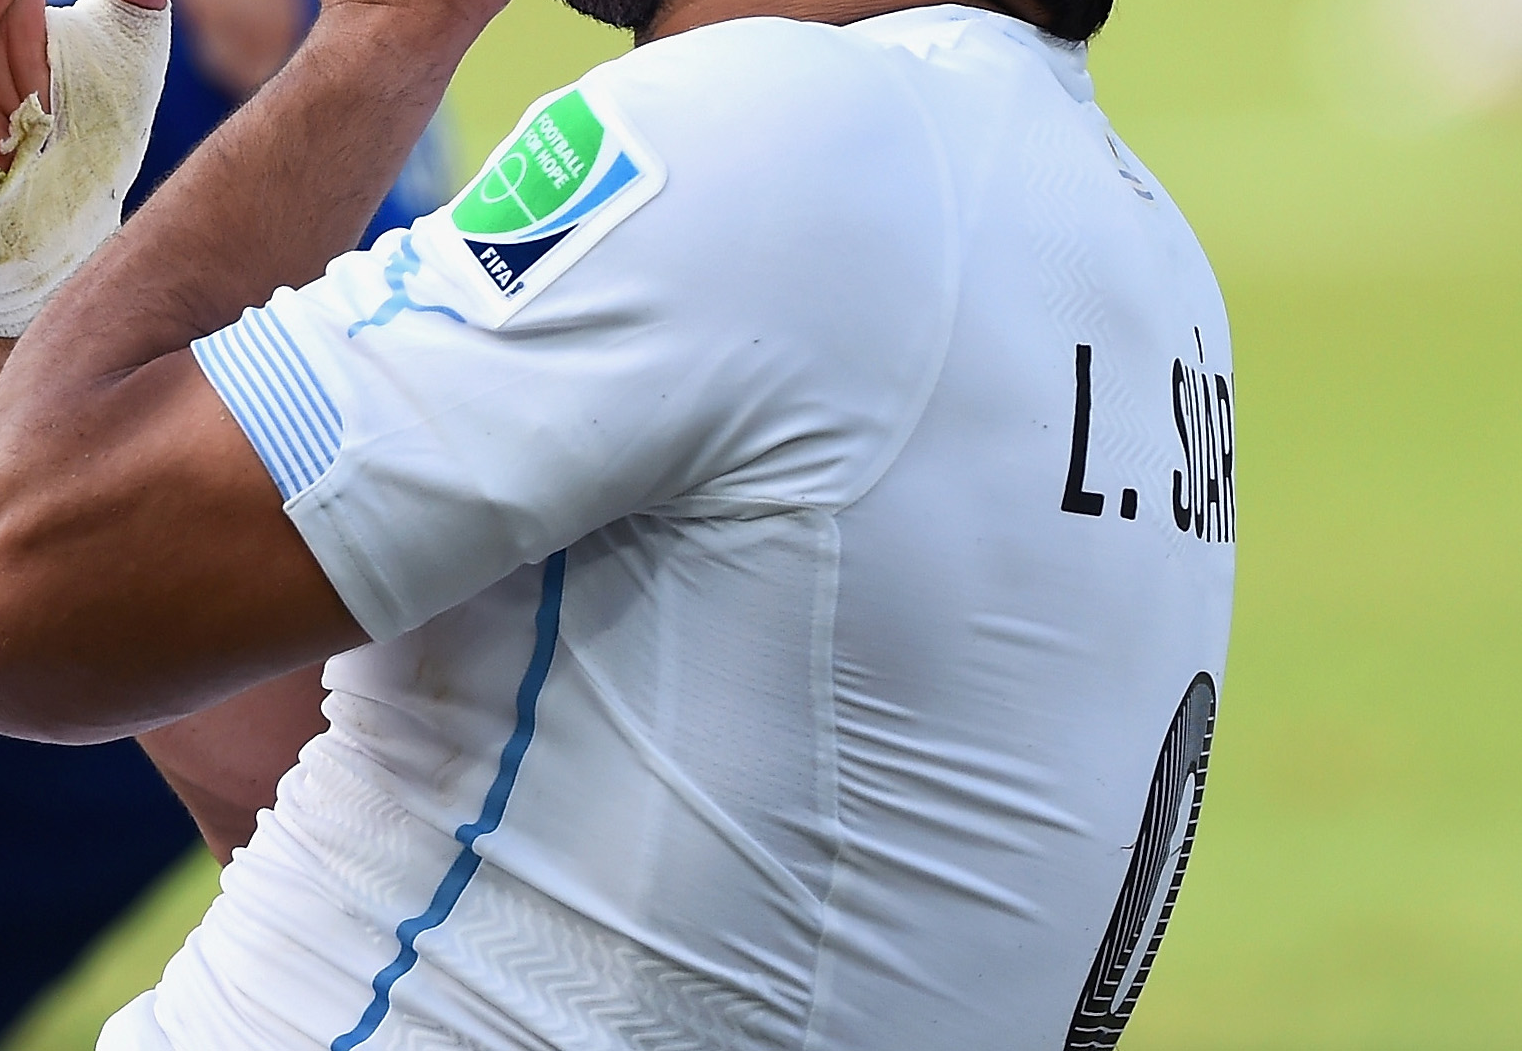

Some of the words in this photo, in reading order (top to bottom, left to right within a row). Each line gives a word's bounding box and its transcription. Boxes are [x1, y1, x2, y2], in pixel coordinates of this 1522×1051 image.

[524, 128, 544, 154] FOR
[535, 149, 570, 190] HOPE
[537, 113, 585, 178] FOOTBALL
[479, 246, 513, 287] FIFA
[1061, 344, 1138, 521] L.
